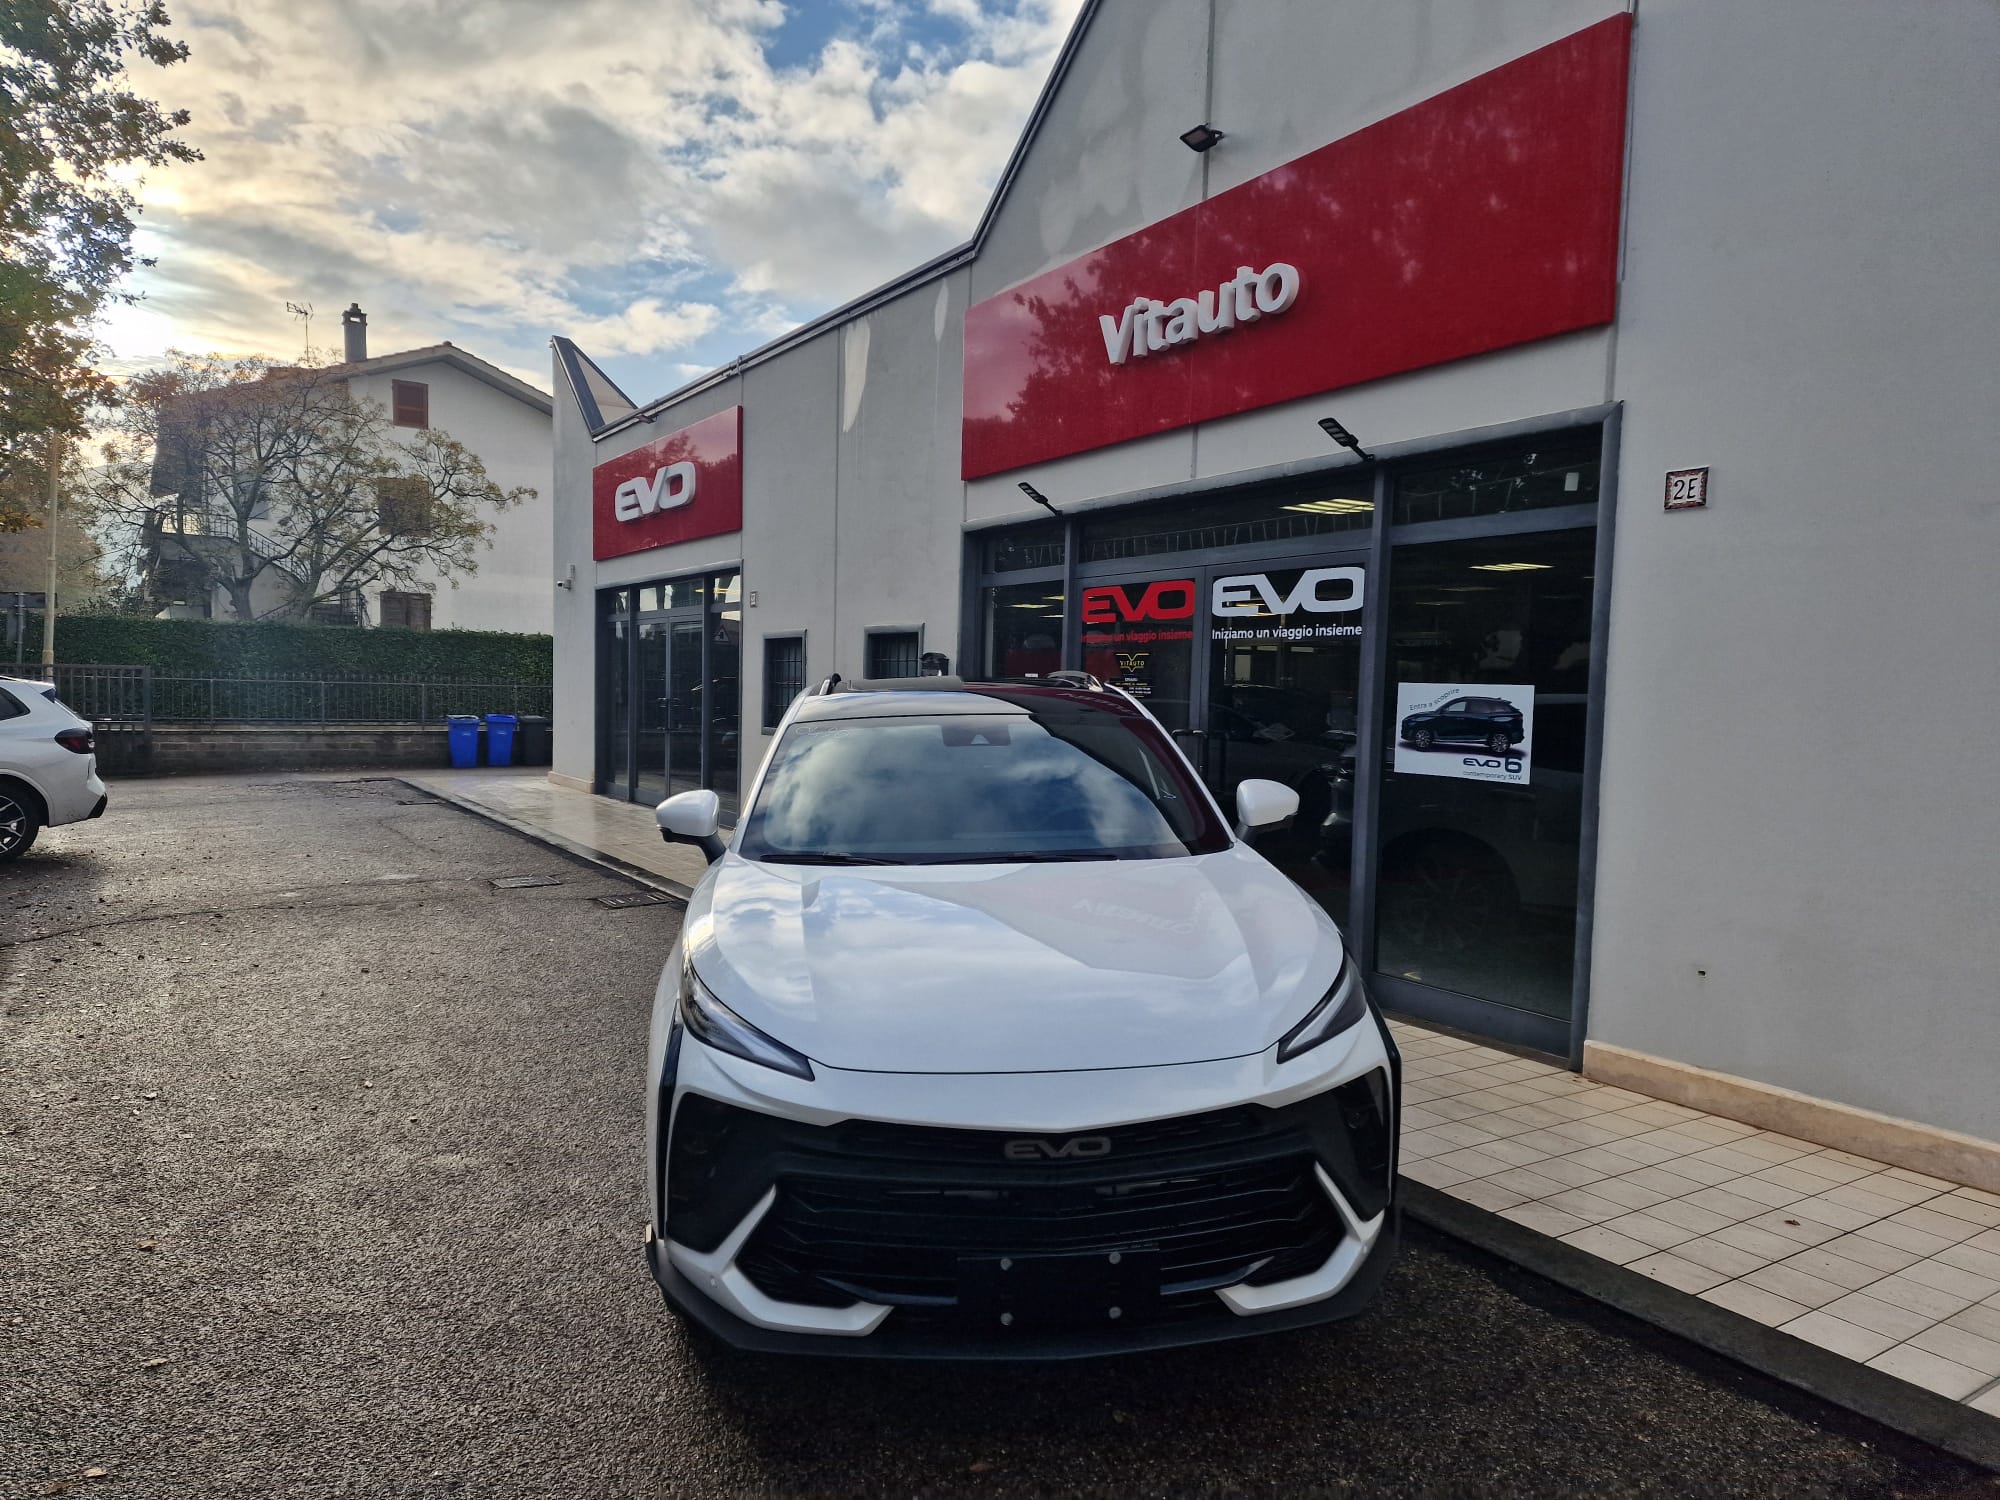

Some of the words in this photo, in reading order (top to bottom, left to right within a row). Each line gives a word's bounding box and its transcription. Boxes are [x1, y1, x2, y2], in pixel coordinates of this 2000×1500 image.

[1099, 262, 1300, 366] Vitauto
[615, 461, 697, 523] EVO
[1673, 477, 1699, 501] 2E
[1081, 579, 1196, 623] EVO
[1211, 566, 1366, 617] EVO
[1211, 626, 1254, 640] Iniziamo
[1256, 628, 1270, 639] un
[1272, 625, 1313, 641] viaggio
[1315, 623, 1363, 638] insieme
[1462, 757, 1502, 769] EVO
[1504, 756, 1523, 774] 6
[1507, 773, 1522, 781] SUV
[1004, 1136, 1111, 1159] EVO
